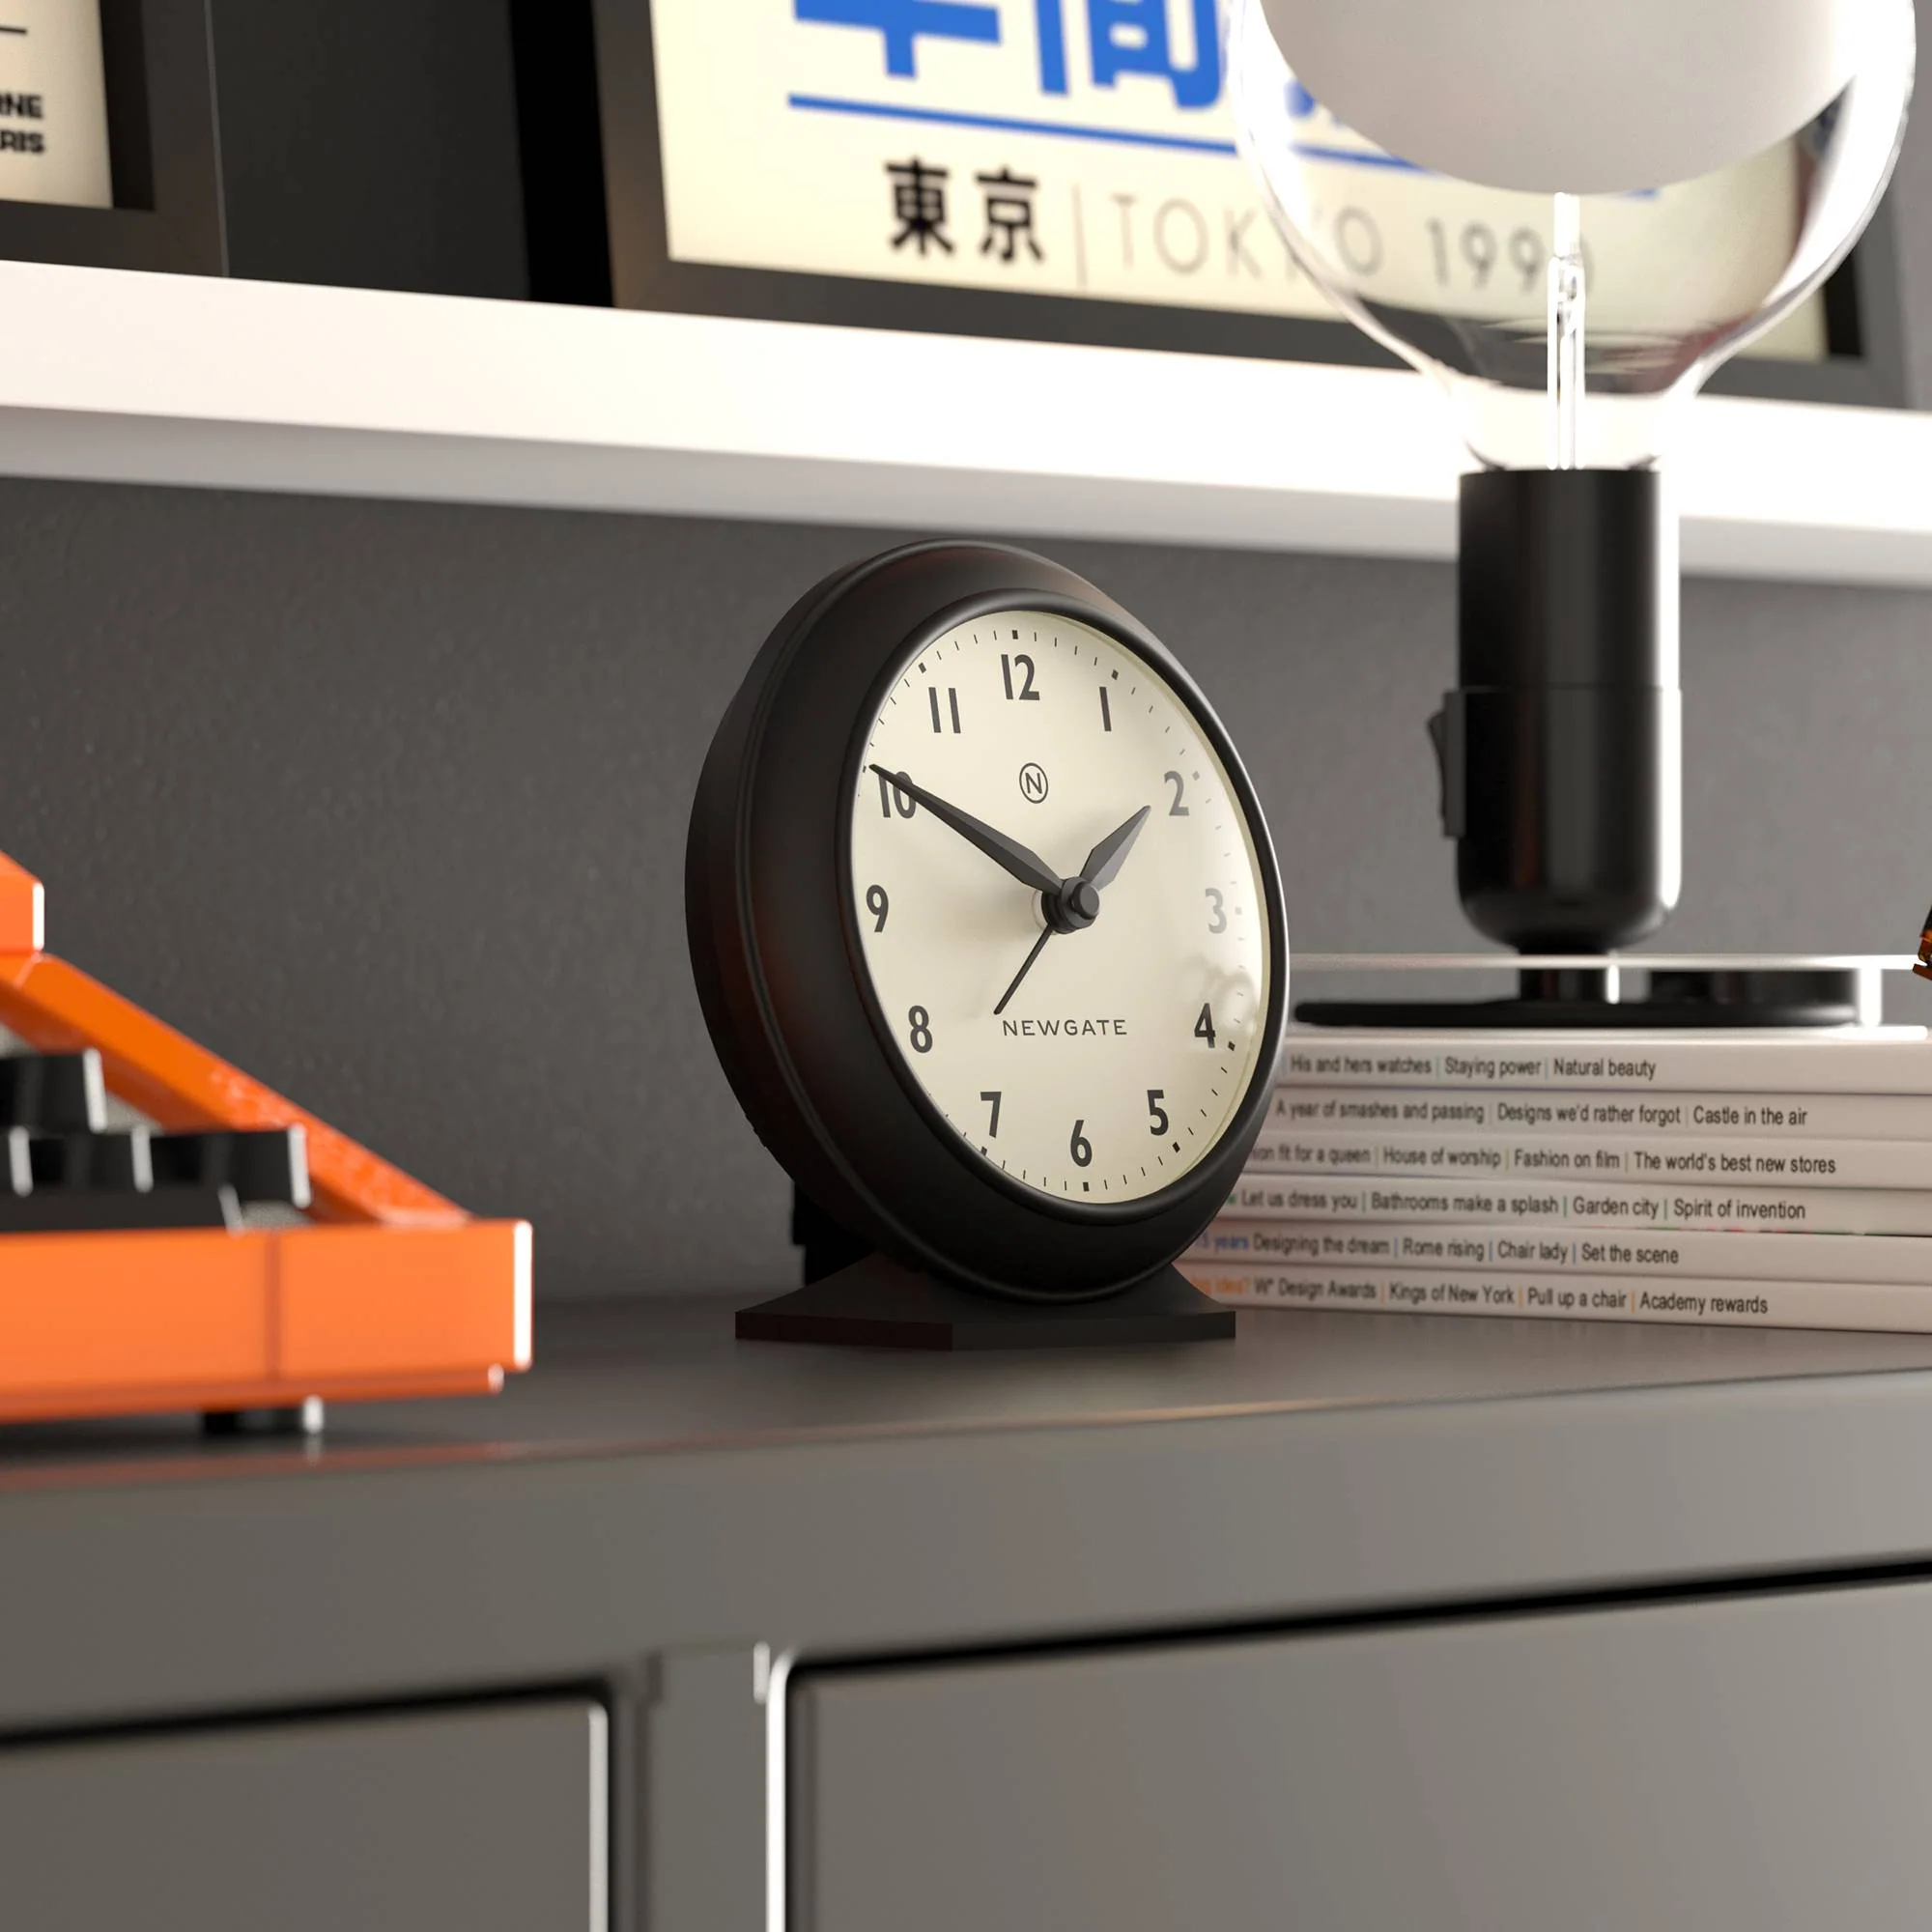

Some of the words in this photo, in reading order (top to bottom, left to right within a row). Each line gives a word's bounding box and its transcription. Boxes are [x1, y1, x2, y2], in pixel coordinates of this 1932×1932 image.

[884, 156, 1045, 263] 東京
[1001, 653, 1040, 700] 12
[928, 687, 961, 733] 11
[1099, 687, 1112, 731] 1
[878, 771, 916, 819] 10
[1164, 770, 1190, 816] 2
[866, 884, 889, 932] 9
[1205, 888, 1228, 934] 3
[908, 1006, 933, 1053] 8
[1003, 1019, 1127, 1037] NEWGATE
[1193, 1003, 1216, 1048] 4
[1317, 1056, 1340, 1073] and
[1378, 1056, 1432, 1074] watches
[1445, 1056, 1495, 1079] Staying
[1499, 1060, 1542, 1079] power
[1554, 1058, 1604, 1076] Natural
[1608, 1059, 1656, 1081] beauty
[980, 1092, 1003, 1138] 7
[1147, 1090, 1169, 1135] 5
[1290, 1103, 1319, 1121] year
[1322, 1100, 1338, 1118] of
[1340, 1101, 1398, 1119] smashes
[1404, 1102, 1427, 1119] and
[1432, 1104, 1484, 1123] passing
[1498, 1103, 1551, 1124] Designs
[1556, 1104, 1589, 1122] we'd
[1593, 1106, 1634, 1122] rather
[1639, 1106, 1681, 1126] forgot
[1693, 1107, 1739, 1125] Castle
[1744, 1107, 1756, 1125] in
[1761, 1108, 1783, 1125] the
[1788, 1108, 1807, 1126] air
[1070, 1120, 1093, 1167] 6
[1294, 1144, 1314, 1161] for
[1318, 1149, 1325, 1163] a
[1328, 1149, 1371, 1165] queen
[1383, 1149, 1427, 1165] House
[1432, 1148, 1445, 1165] of
[1449, 1150, 1501, 1169] worship
[1514, 1149, 1570, 1167] Fashion
[1574, 1153, 1591, 1168] on
[1595, 1150, 1620, 1169] film
[1634, 1151, 1661, 1170] The
[1665, 1152, 1716, 1172] world's
[1720, 1154, 1752, 1173] best
[1756, 1158, 1785, 1173] new
[1790, 1157, 1836, 1175] stores
[1241, 1189, 1264, 1208] Let
[1267, 1193, 1283, 1208] us
[1289, 1190, 1326, 1208] dress
[1331, 1195, 1357, 1212] you
[1372, 1193, 1448, 1212] Bathrooms
[1453, 1193, 1492, 1211] make
[1498, 1199, 1506, 1212] a
[1511, 1195, 1559, 1216] splash
[1573, 1196, 1628, 1216] Garden
[1633, 1197, 1659, 1220] city
[1674, 1198, 1713, 1220] Spirit
[1718, 1199, 1732, 1217] of
[1737, 1199, 1805, 1219] invention
[1254, 1233, 1319, 1255] Designing
[1323, 1234, 1344, 1252] the
[1348, 1235, 1389, 1253] dream
[1404, 1236, 1443, 1255] Rome
[1447, 1237, 1485, 1262] rising
[1498, 1240, 1535, 1259] Chair
[1539, 1241, 1568, 1264] lady
[1581, 1242, 1606, 1262] Set
[1609, 1243, 1632, 1263] the
[1636, 1248, 1679, 1264] scene
[1278, 1278, 1323, 1300] Design
[1328, 1280, 1377, 1300] Awards
[1390, 1284, 1427, 1306] Kings
[1432, 1285, 1446, 1301] of
[1449, 1286, 1478, 1303] New
[1482, 1287, 1514, 1305] York
[1528, 1287, 1553, 1305] Pull
[1558, 1291, 1576, 1310] up
[1580, 1293, 1587, 1306] a
[1592, 1289, 1627, 1308] chair
[1640, 1292, 1706, 1316] Academy
[1711, 1294, 1768, 1315] rewards
